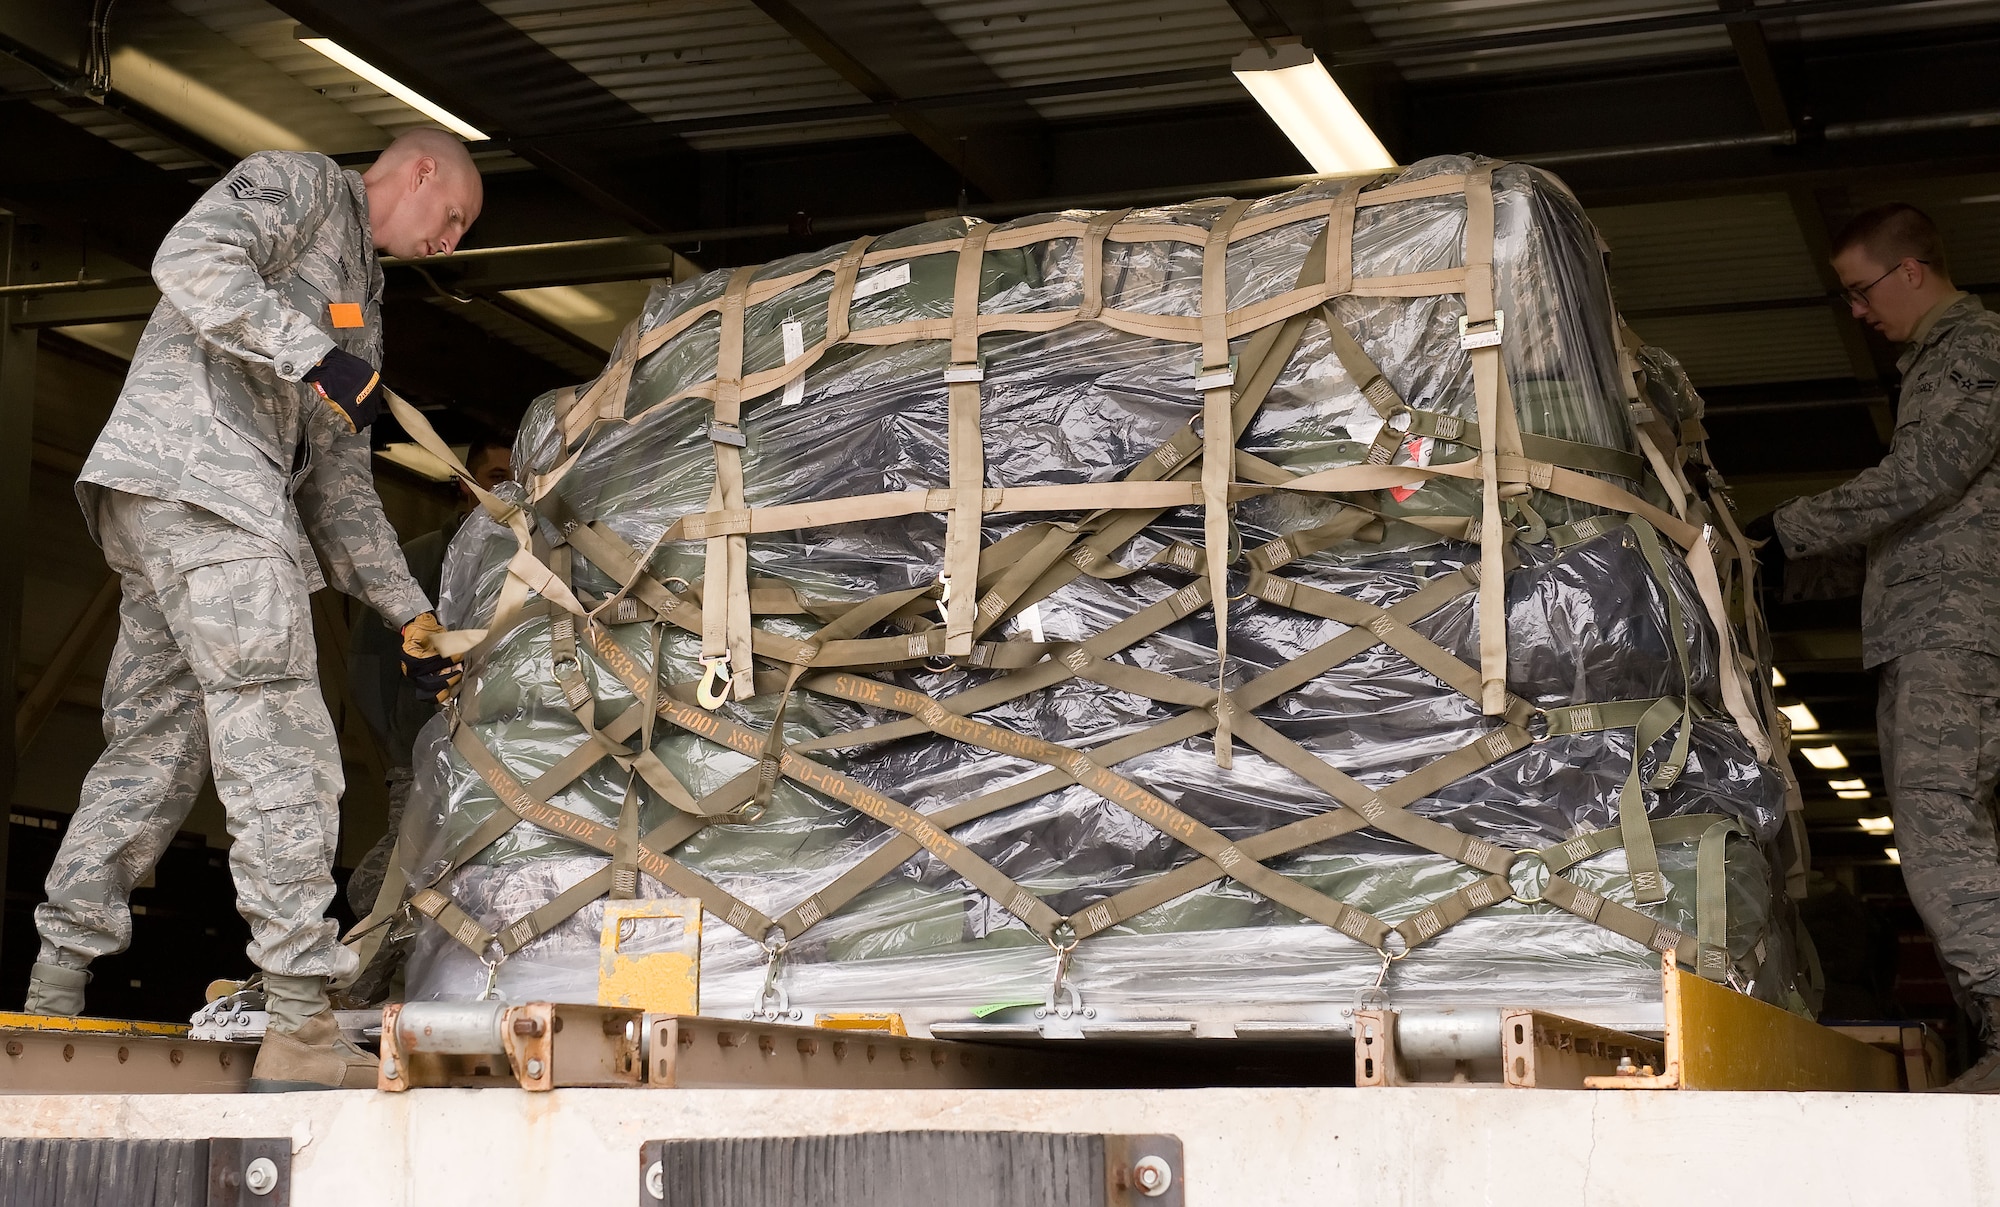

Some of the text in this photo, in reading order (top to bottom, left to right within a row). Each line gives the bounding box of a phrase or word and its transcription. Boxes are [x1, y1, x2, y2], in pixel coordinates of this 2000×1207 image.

[835, 676, 884, 703] SIDE
[727, 729, 766, 756] NSN
[528, 803, 602, 842] OUTSIDE
[605, 833, 670, 877] BTOM
